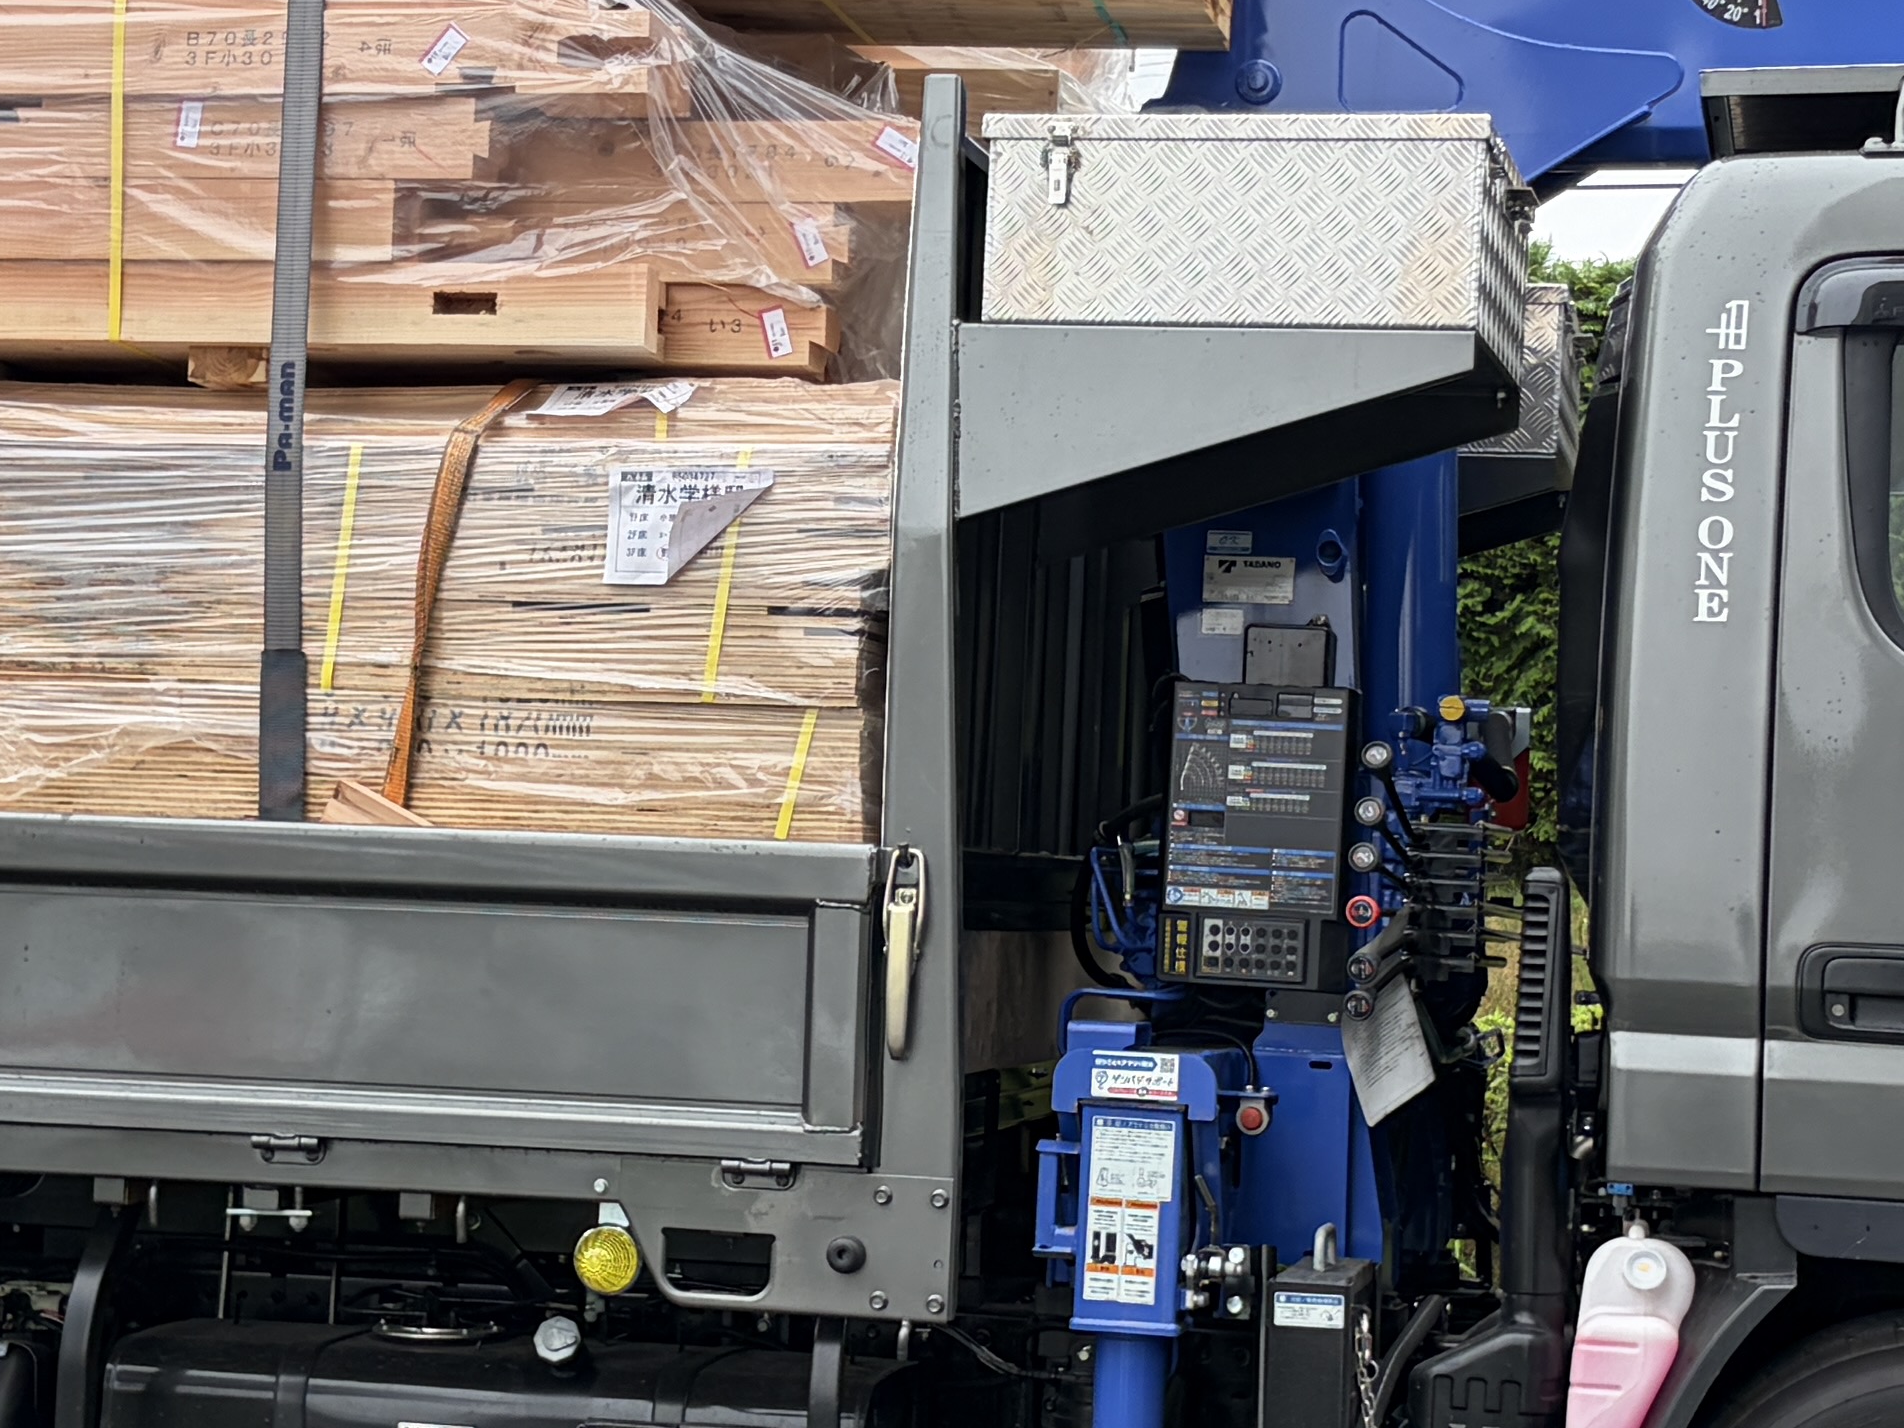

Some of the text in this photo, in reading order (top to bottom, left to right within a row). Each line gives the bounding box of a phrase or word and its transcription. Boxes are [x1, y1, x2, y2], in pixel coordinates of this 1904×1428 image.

[1692, 359, 1744, 622] PLUS ONE
[1242, 560, 1282, 570] TADANO
